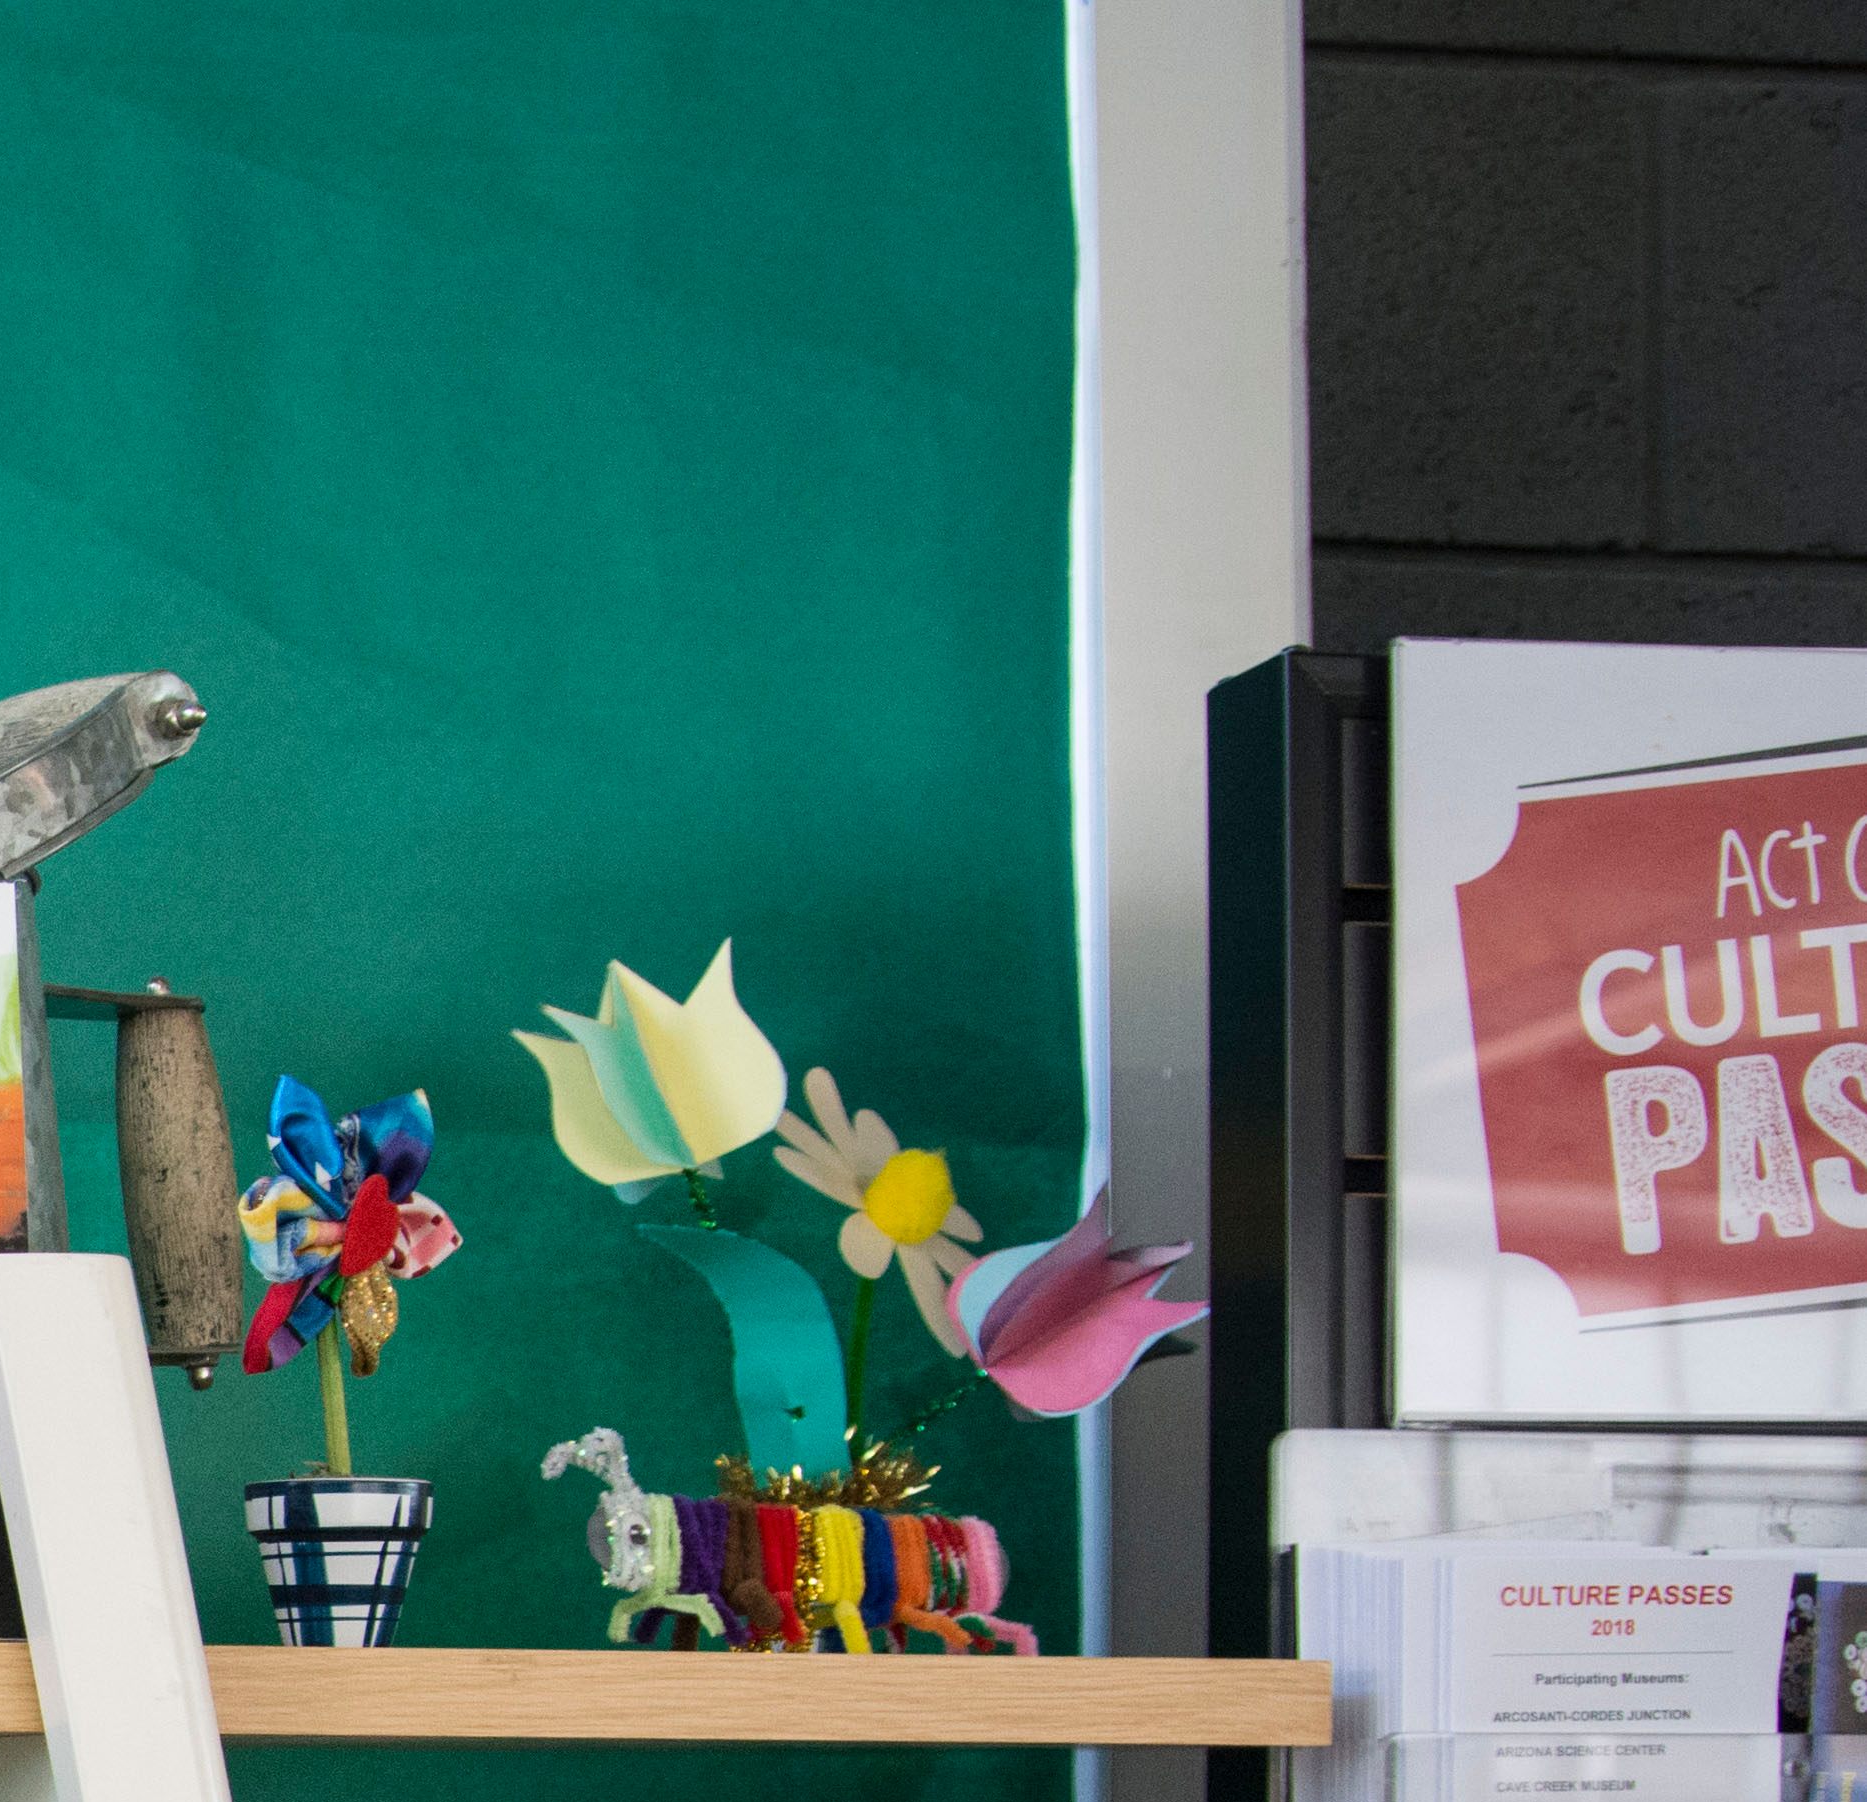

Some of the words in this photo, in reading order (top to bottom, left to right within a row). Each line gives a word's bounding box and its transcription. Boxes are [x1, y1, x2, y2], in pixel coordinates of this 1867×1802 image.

[1580, 923, 1867, 1055] CULT
[1501, 1586, 1620, 1606] CULTURE
[1628, 1585, 1734, 1606] PASSES
[1591, 1620, 1635, 1636] 2018
[1535, 1674, 1617, 1686] Participating
[1622, 1673, 1689, 1684] Museums:
[1493, 1711, 1624, 1722] ARCOSANTI-CORDES
[1627, 1710, 1691, 1721] JUNCTION
